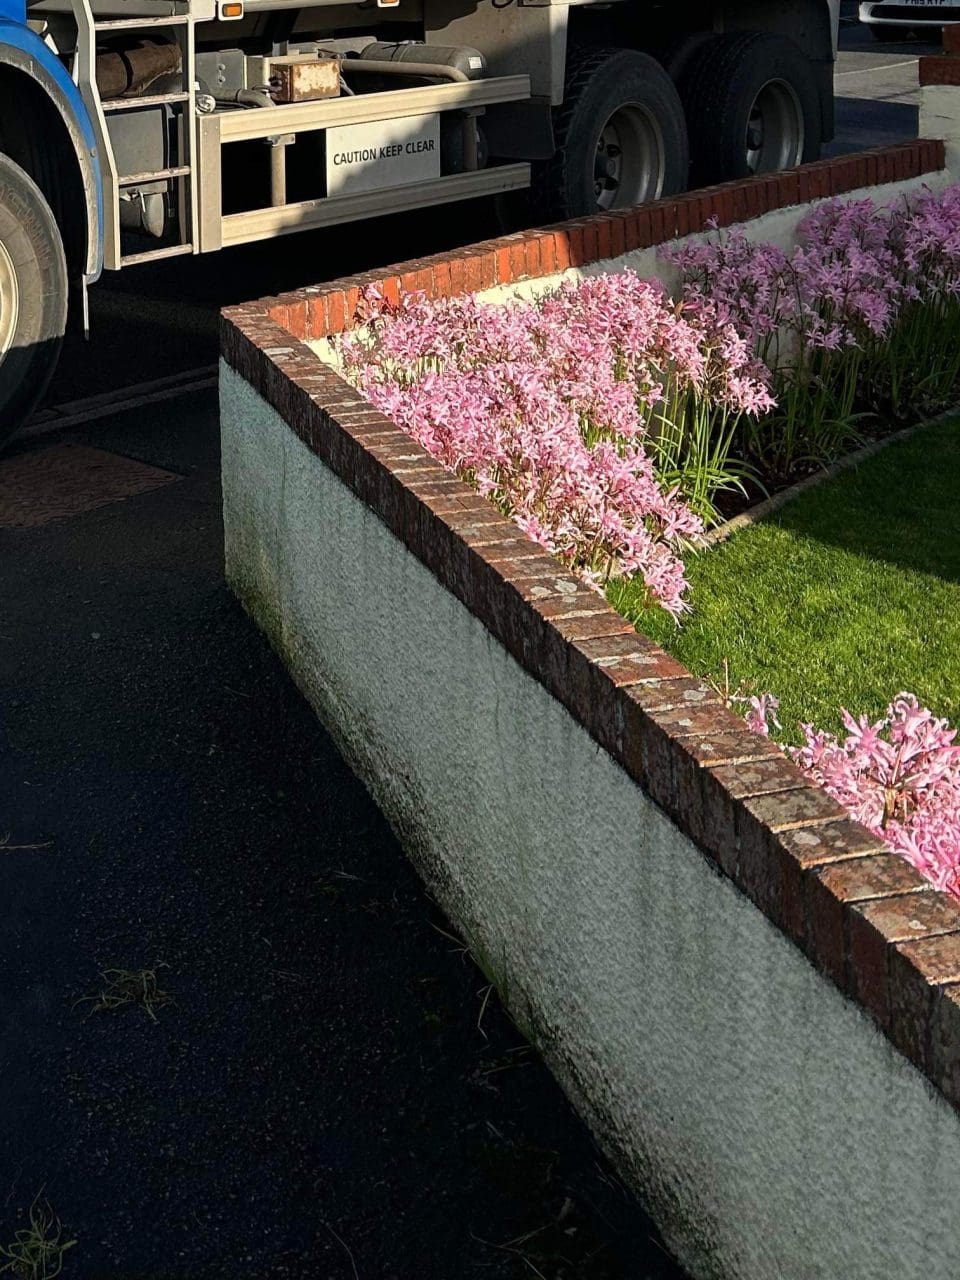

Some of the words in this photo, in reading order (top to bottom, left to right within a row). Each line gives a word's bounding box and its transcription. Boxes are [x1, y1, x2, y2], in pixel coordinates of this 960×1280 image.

[333, 148, 377, 166] CAUTION
[379, 144, 403, 159] KEEP
[405, 139, 435, 154] CLEAR
